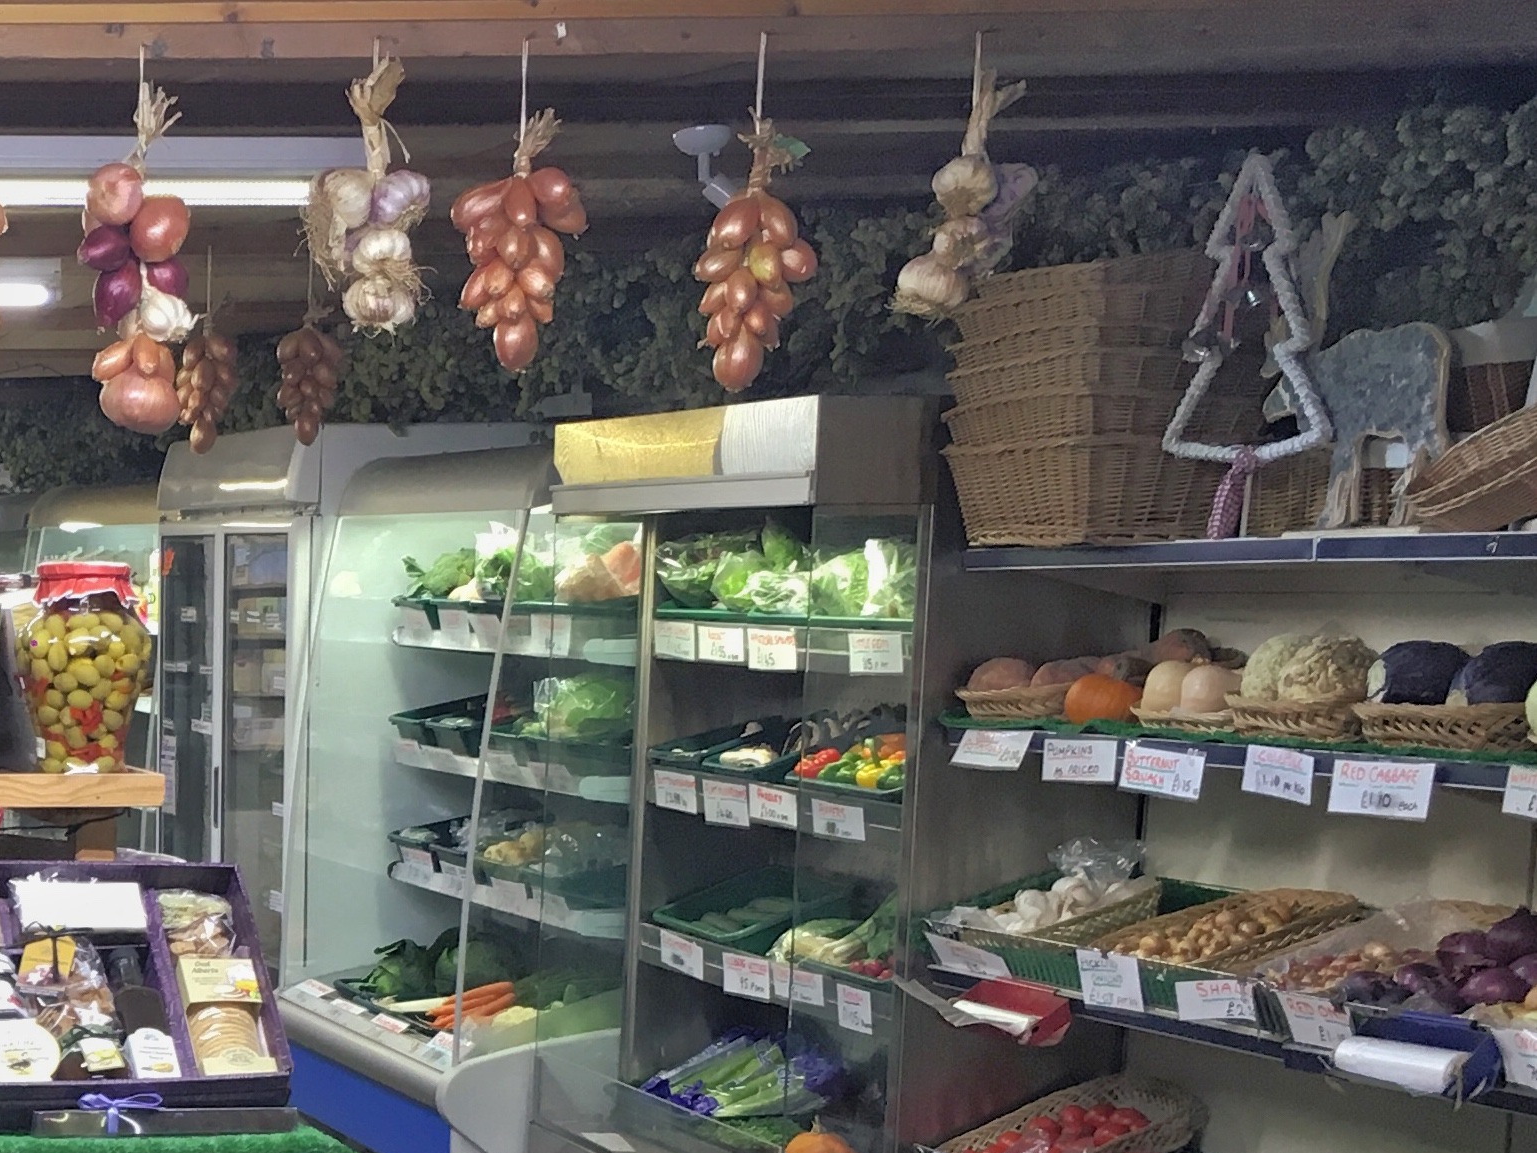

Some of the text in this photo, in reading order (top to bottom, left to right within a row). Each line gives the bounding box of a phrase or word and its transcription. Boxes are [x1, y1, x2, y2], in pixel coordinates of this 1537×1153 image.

[1047, 743, 1094, 756] PUMPKINS
[1126, 749, 1180, 770] BUTTERNUT
[1069, 764, 1101, 776] PRICED
[1125, 767, 1165, 784] SQUASH
[1340, 764, 1420, 785] RED CABBAGE
